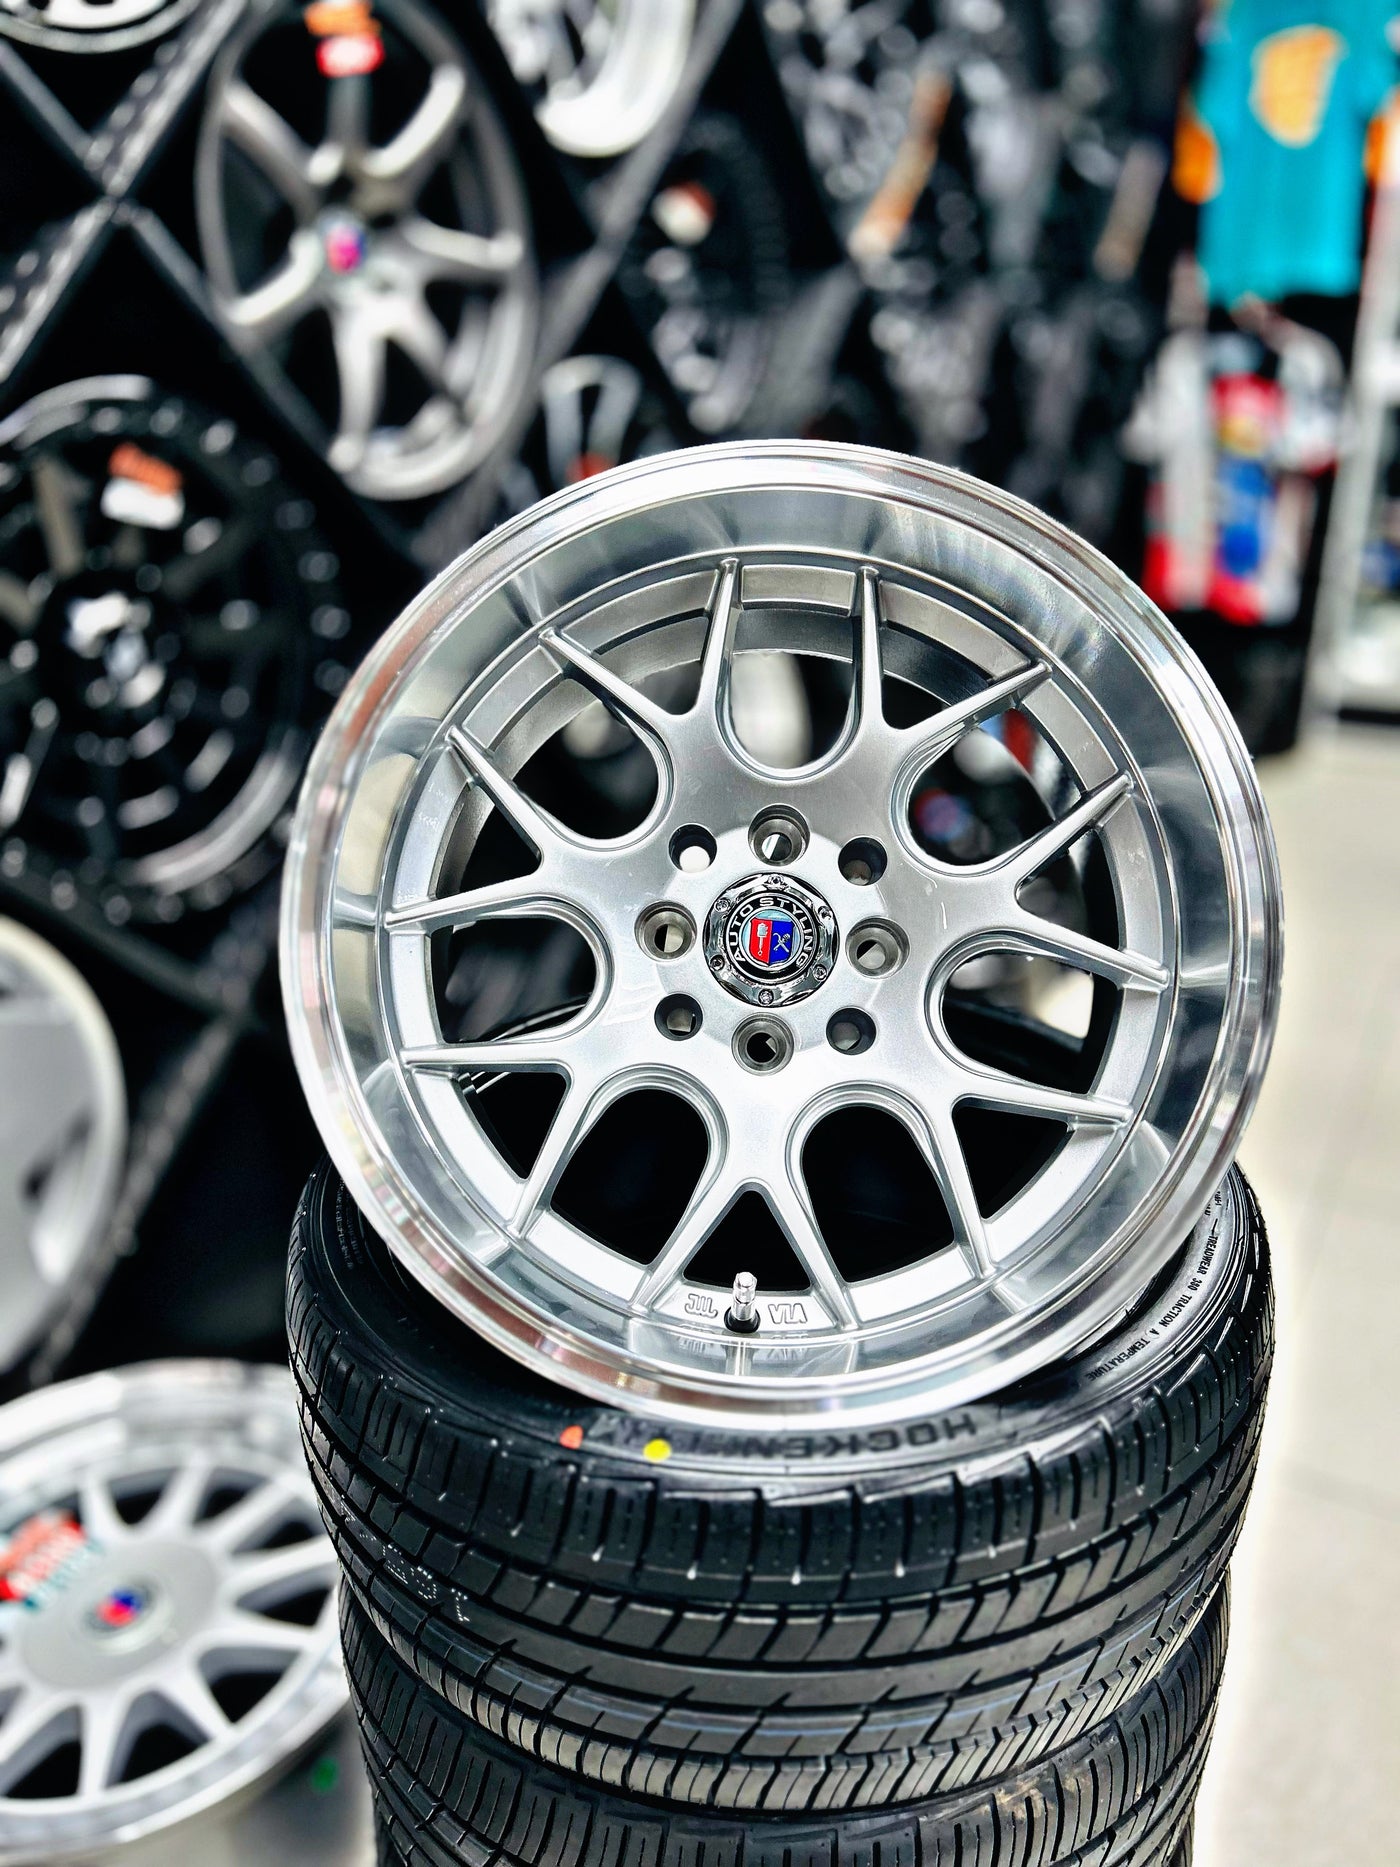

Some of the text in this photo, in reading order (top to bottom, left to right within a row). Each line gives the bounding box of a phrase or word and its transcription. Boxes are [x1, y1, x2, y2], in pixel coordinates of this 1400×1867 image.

[729, 897, 813, 969] AUTO STYLING
[1196, 1235, 1218, 1275] TREADWEAR
[768, 1303, 807, 1324] VIA
[1159, 1293, 1193, 1328] TRACTION
[1086, 1336, 1151, 1381] TEMPERATURE
